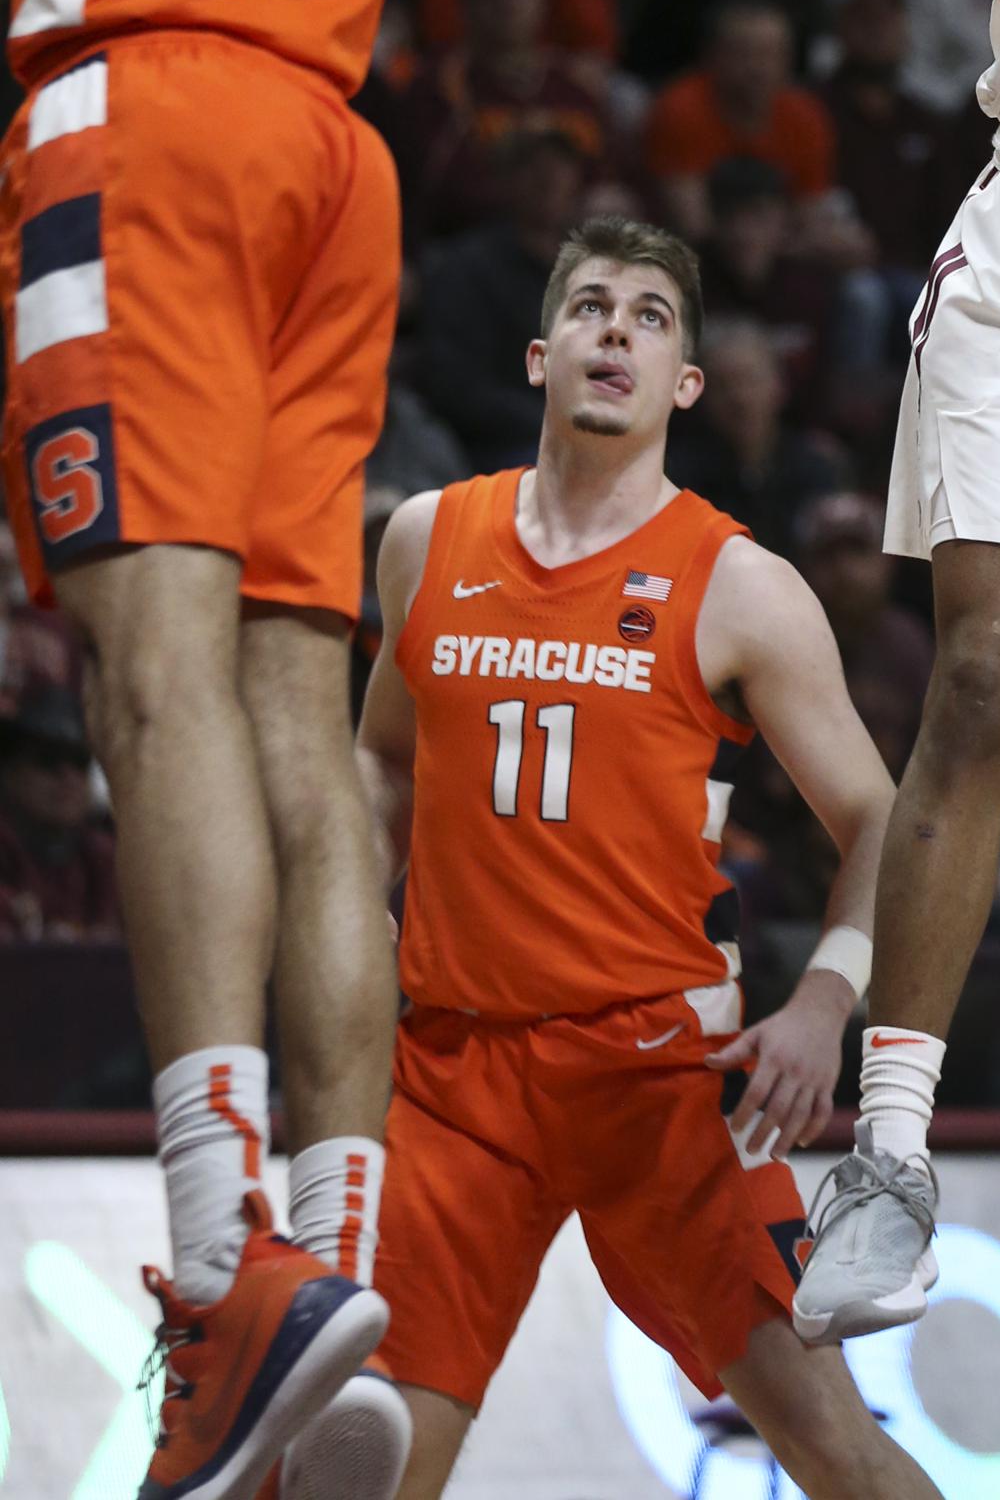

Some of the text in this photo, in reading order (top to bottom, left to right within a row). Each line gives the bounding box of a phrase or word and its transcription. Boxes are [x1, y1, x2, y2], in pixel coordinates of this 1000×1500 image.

[32, 426, 104, 544] S
[431, 634, 656, 693] SYRACUSE
[487, 698, 576, 822] 11
